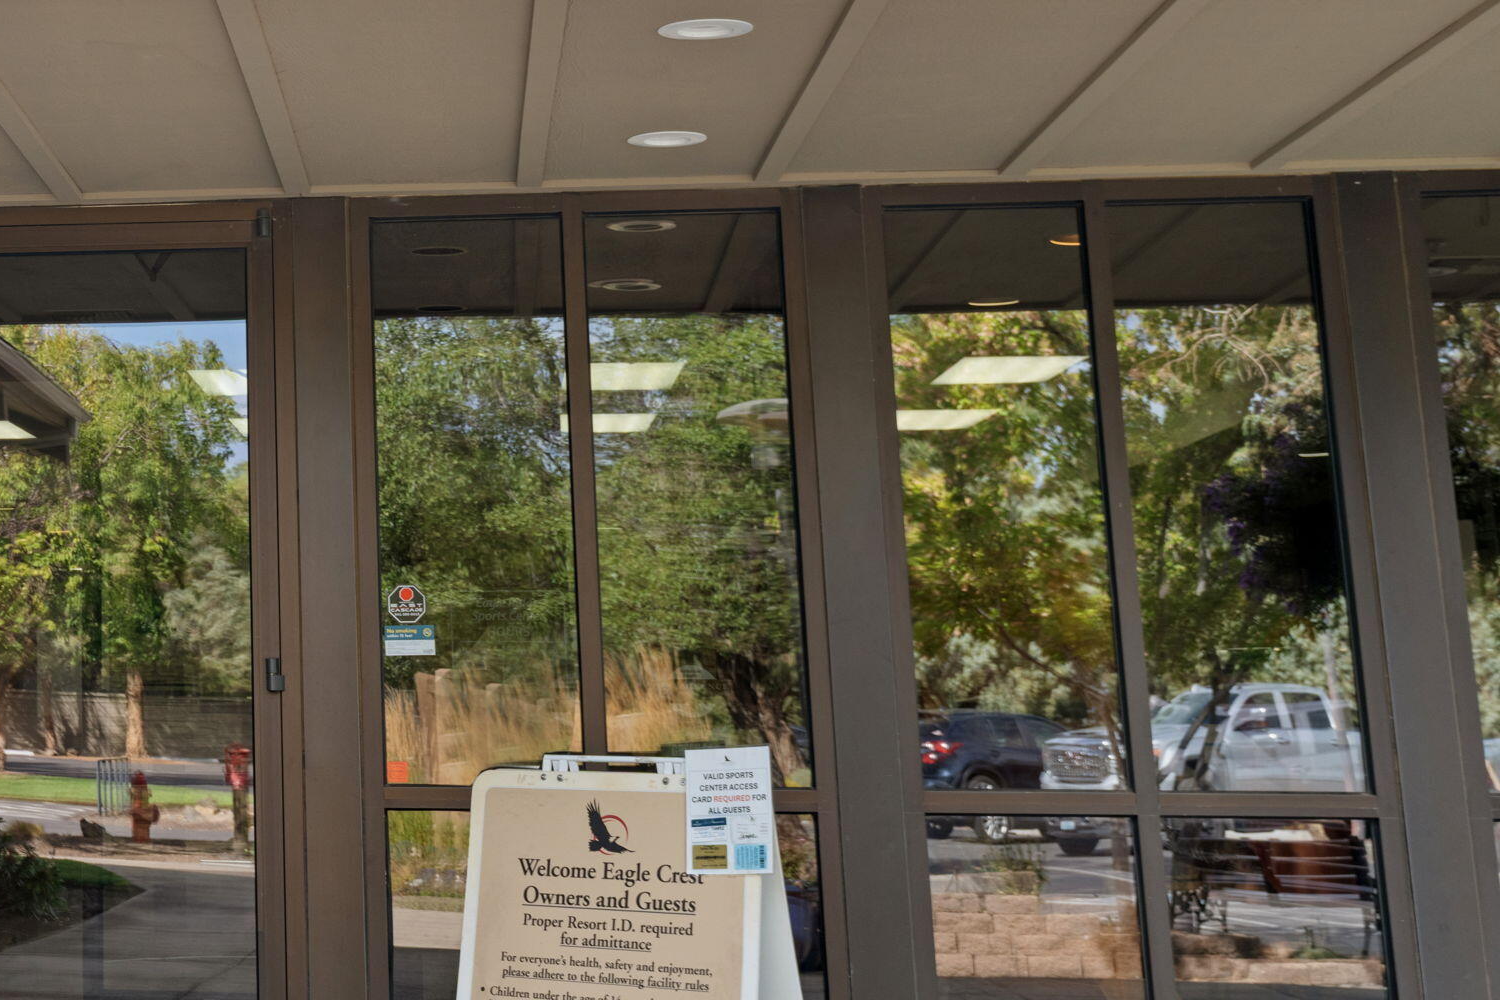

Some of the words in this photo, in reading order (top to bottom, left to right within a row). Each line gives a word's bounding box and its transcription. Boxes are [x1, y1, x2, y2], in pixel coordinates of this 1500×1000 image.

[703, 772, 724, 780] VALID
[725, 771, 754, 779] SPORTS
[713, 794, 751, 803] REQUIRED
[751, 793, 767, 801] FOR
[722, 805, 751, 814] GUESTS
[518, 857, 597, 879] Welcome
[601, 861, 650, 887] Eagle
[523, 885, 591, 906] Owners
[596, 890, 629, 909] and
[636, 891, 696, 913] Guests
[523, 913, 564, 931] Proper
[568, 915, 607, 931] Resort
[611, 918, 635, 932] I.D.
[640, 922, 693, 938] required
[560, 932, 578, 946] for
[582, 934, 651, 950] admittance
[501, 951, 517, 962] For
[520, 955, 567, 967] everyone's
[569, 955, 601, 969] health,
[605, 959, 632, 973] safety
[636, 962, 655, 972] and
[658, 963, 713, 977] enjoyment,
[502, 966, 531, 979] please
[533, 968, 565, 980] adhere
[567, 972, 577, 981] to
[580, 972, 596, 983] the
[598, 972, 644, 989] following
[647, 975, 682, 991] facility
[685, 979, 710, 991] rules
[490, 985, 530, 999] Children
[532, 990, 560, 1000] under
[562, 992, 577, 1000] the
